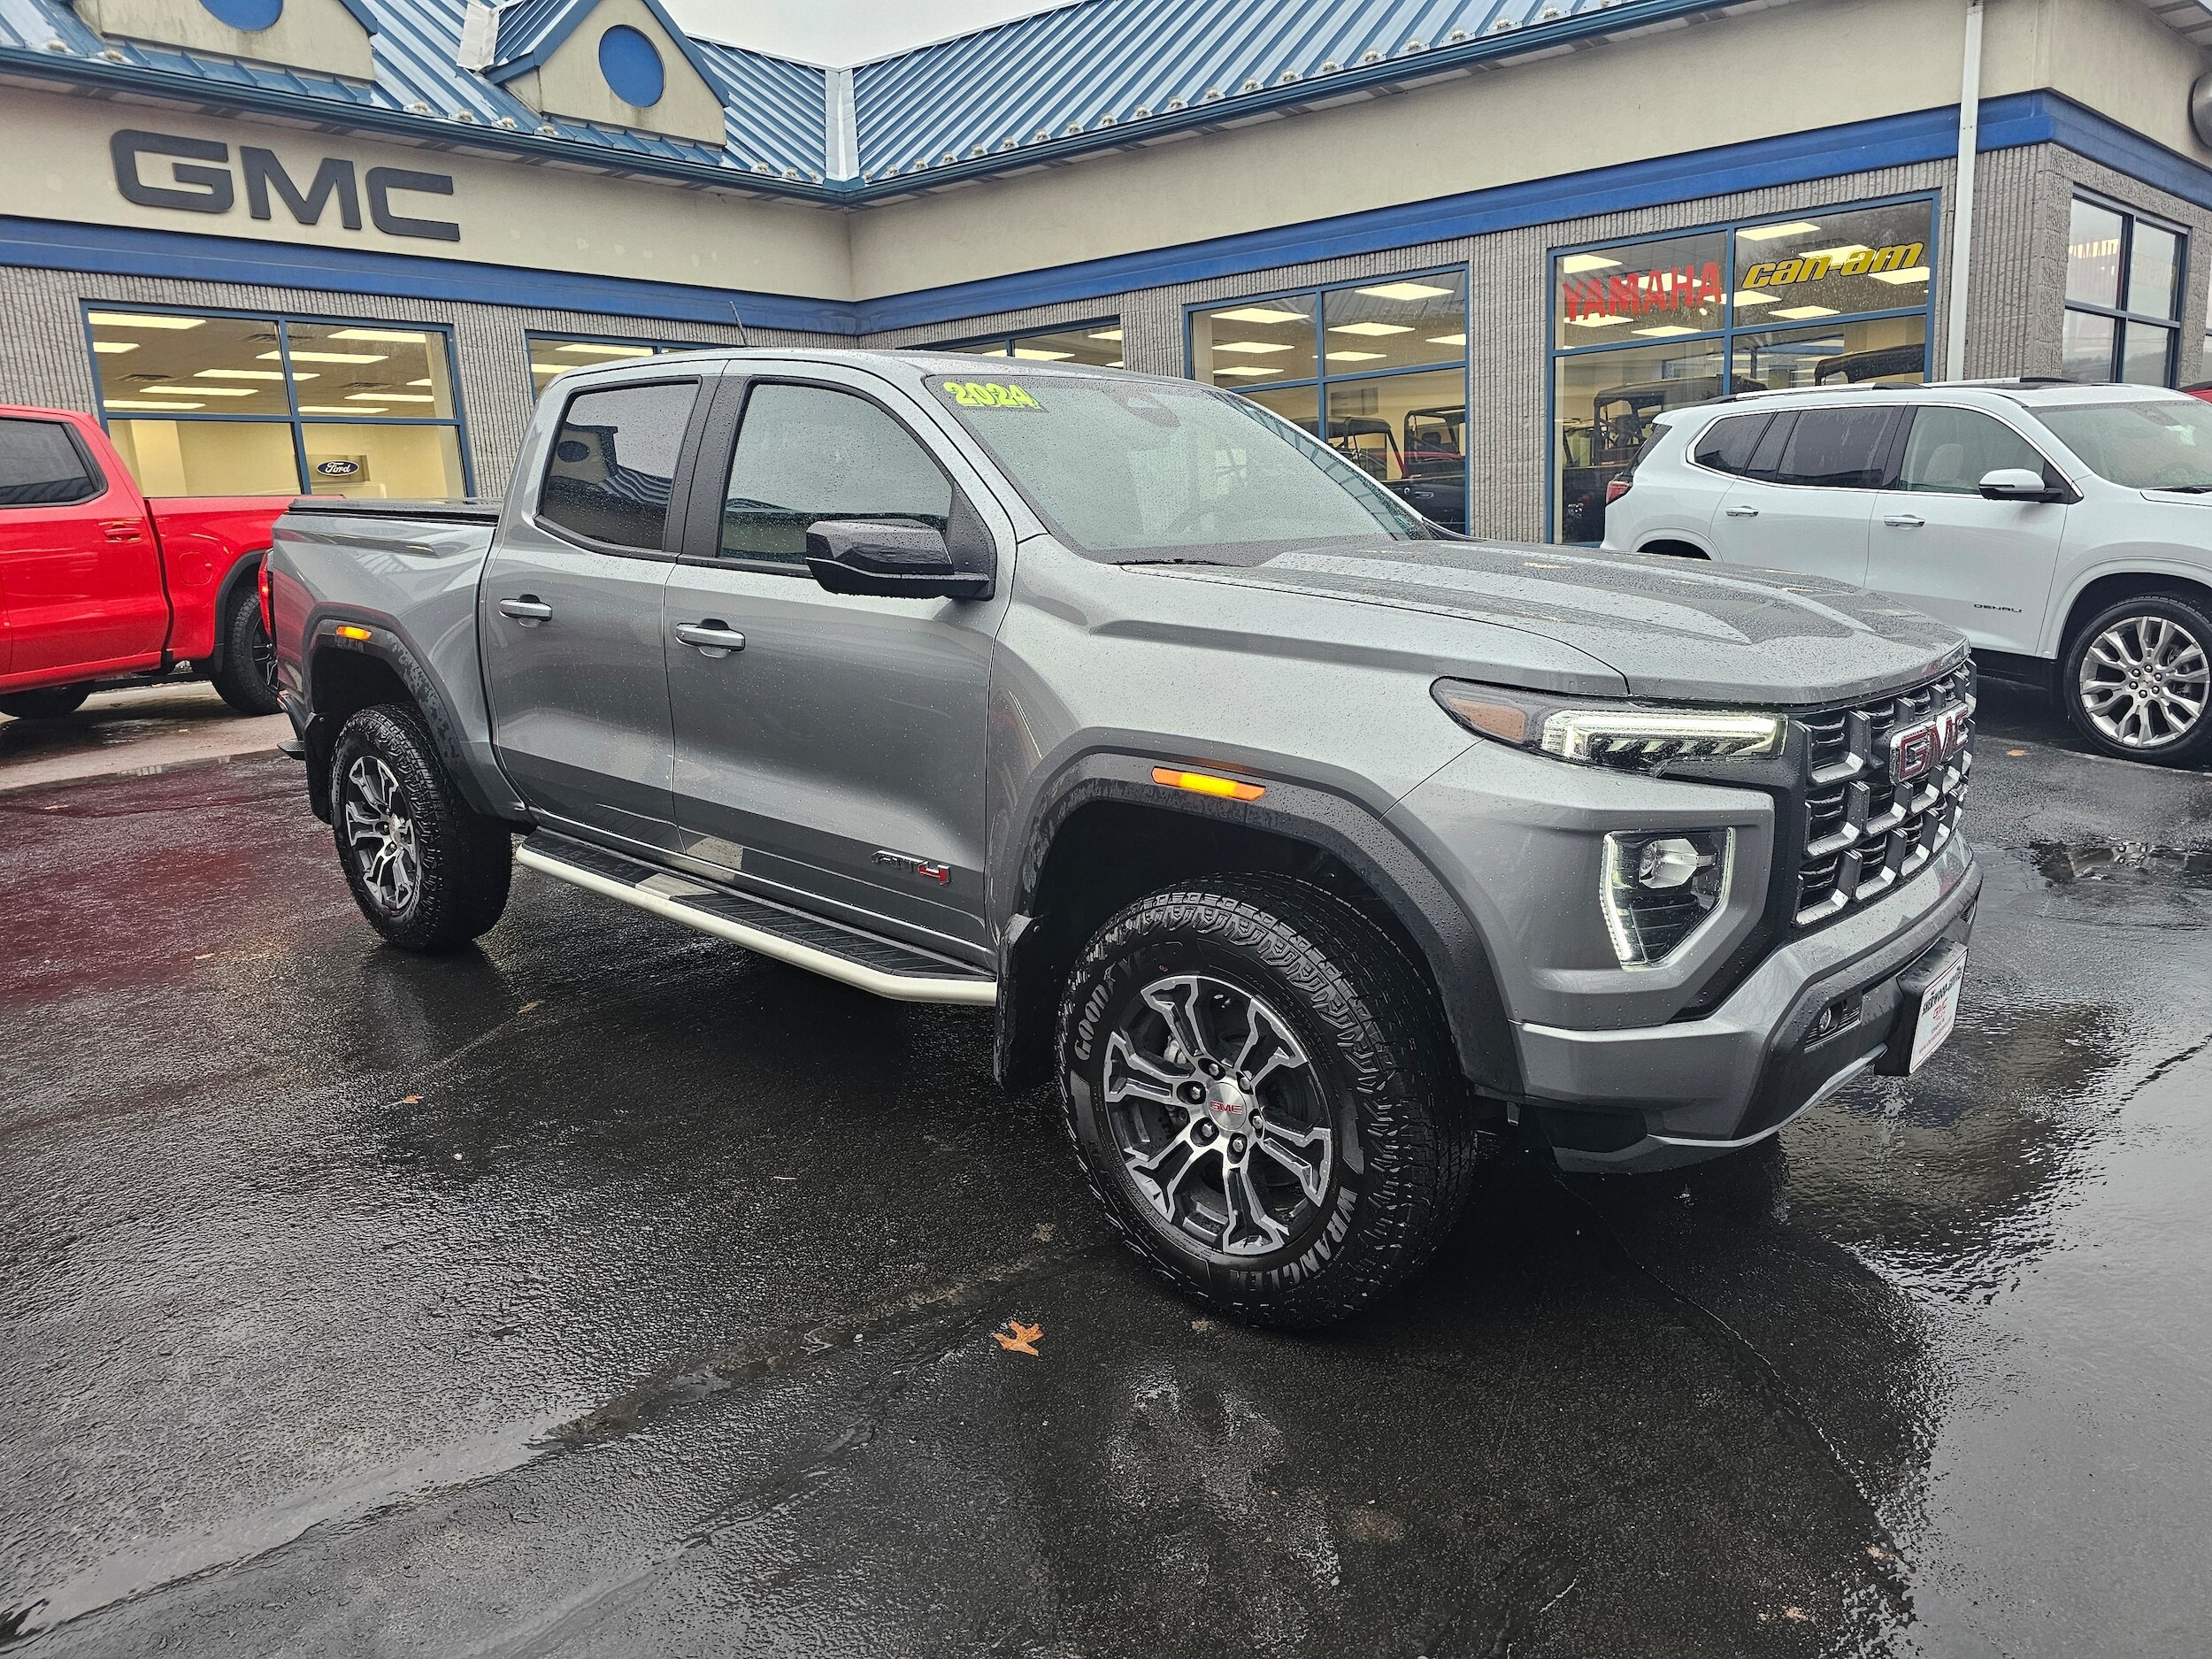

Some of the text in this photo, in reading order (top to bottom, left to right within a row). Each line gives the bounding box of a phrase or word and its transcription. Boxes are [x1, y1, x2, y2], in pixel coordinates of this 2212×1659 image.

[110, 128, 461, 242] GMC
[1563, 261, 1722, 321] YAMAHA
[942, 381, 1042, 410] 2024
[325, 462, 351, 473] Ford
[1973, 603, 2023, 614] DENALI
[1893, 704, 1969, 782] GMC
[1210, 1100, 1243, 1114] GMC
